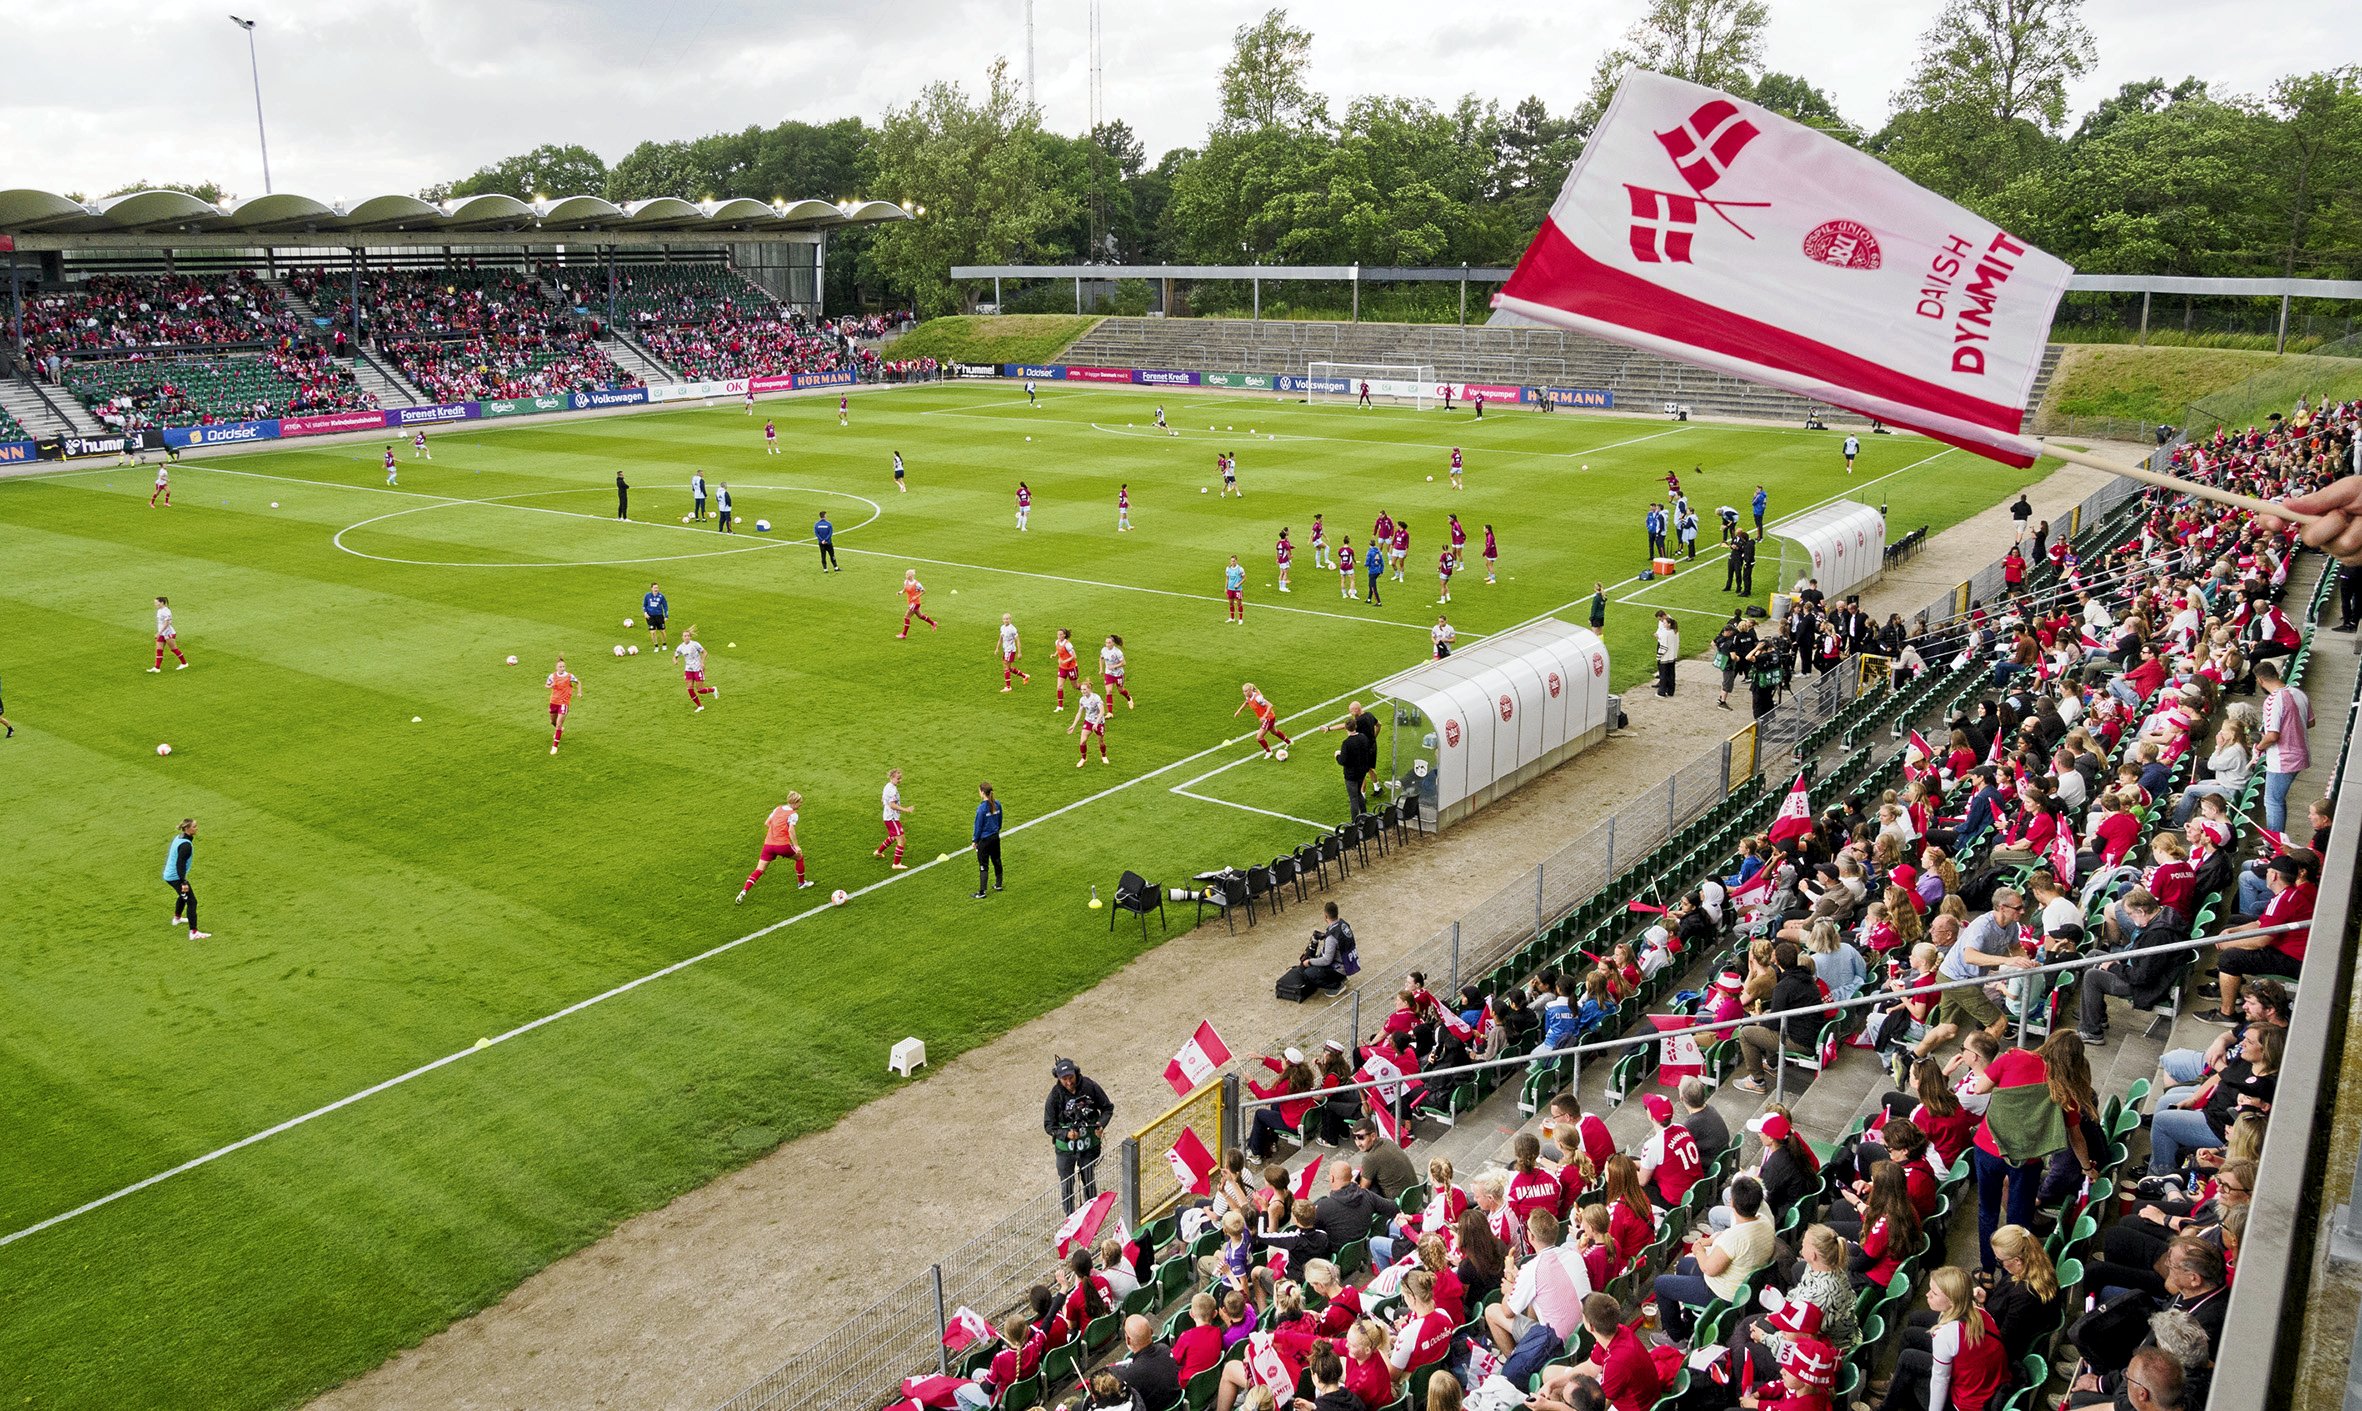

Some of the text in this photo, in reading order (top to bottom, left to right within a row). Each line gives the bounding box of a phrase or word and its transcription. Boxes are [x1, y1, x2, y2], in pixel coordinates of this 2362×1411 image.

[1916, 234, 1973, 320] DAISH
[962, 364, 995, 375] hummel
[1026, 368, 1053, 377] Oddset
[1143, 371, 1189, 381] Forenet Kredit
[726, 381, 743, 392] OK
[592, 392, 643, 405] Volkswagen
[1527, 390, 1605, 405] HRMANN
[401, 406, 466, 420] Forenet Kredit
[207, 426, 256, 442] Oddset
[81, 433, 144, 453] humml
[1674, 1141, 1699, 1170] 10
[1515, 1183, 1556, 1200] DANMARK
[1781, 1343, 1792, 1361] OK
